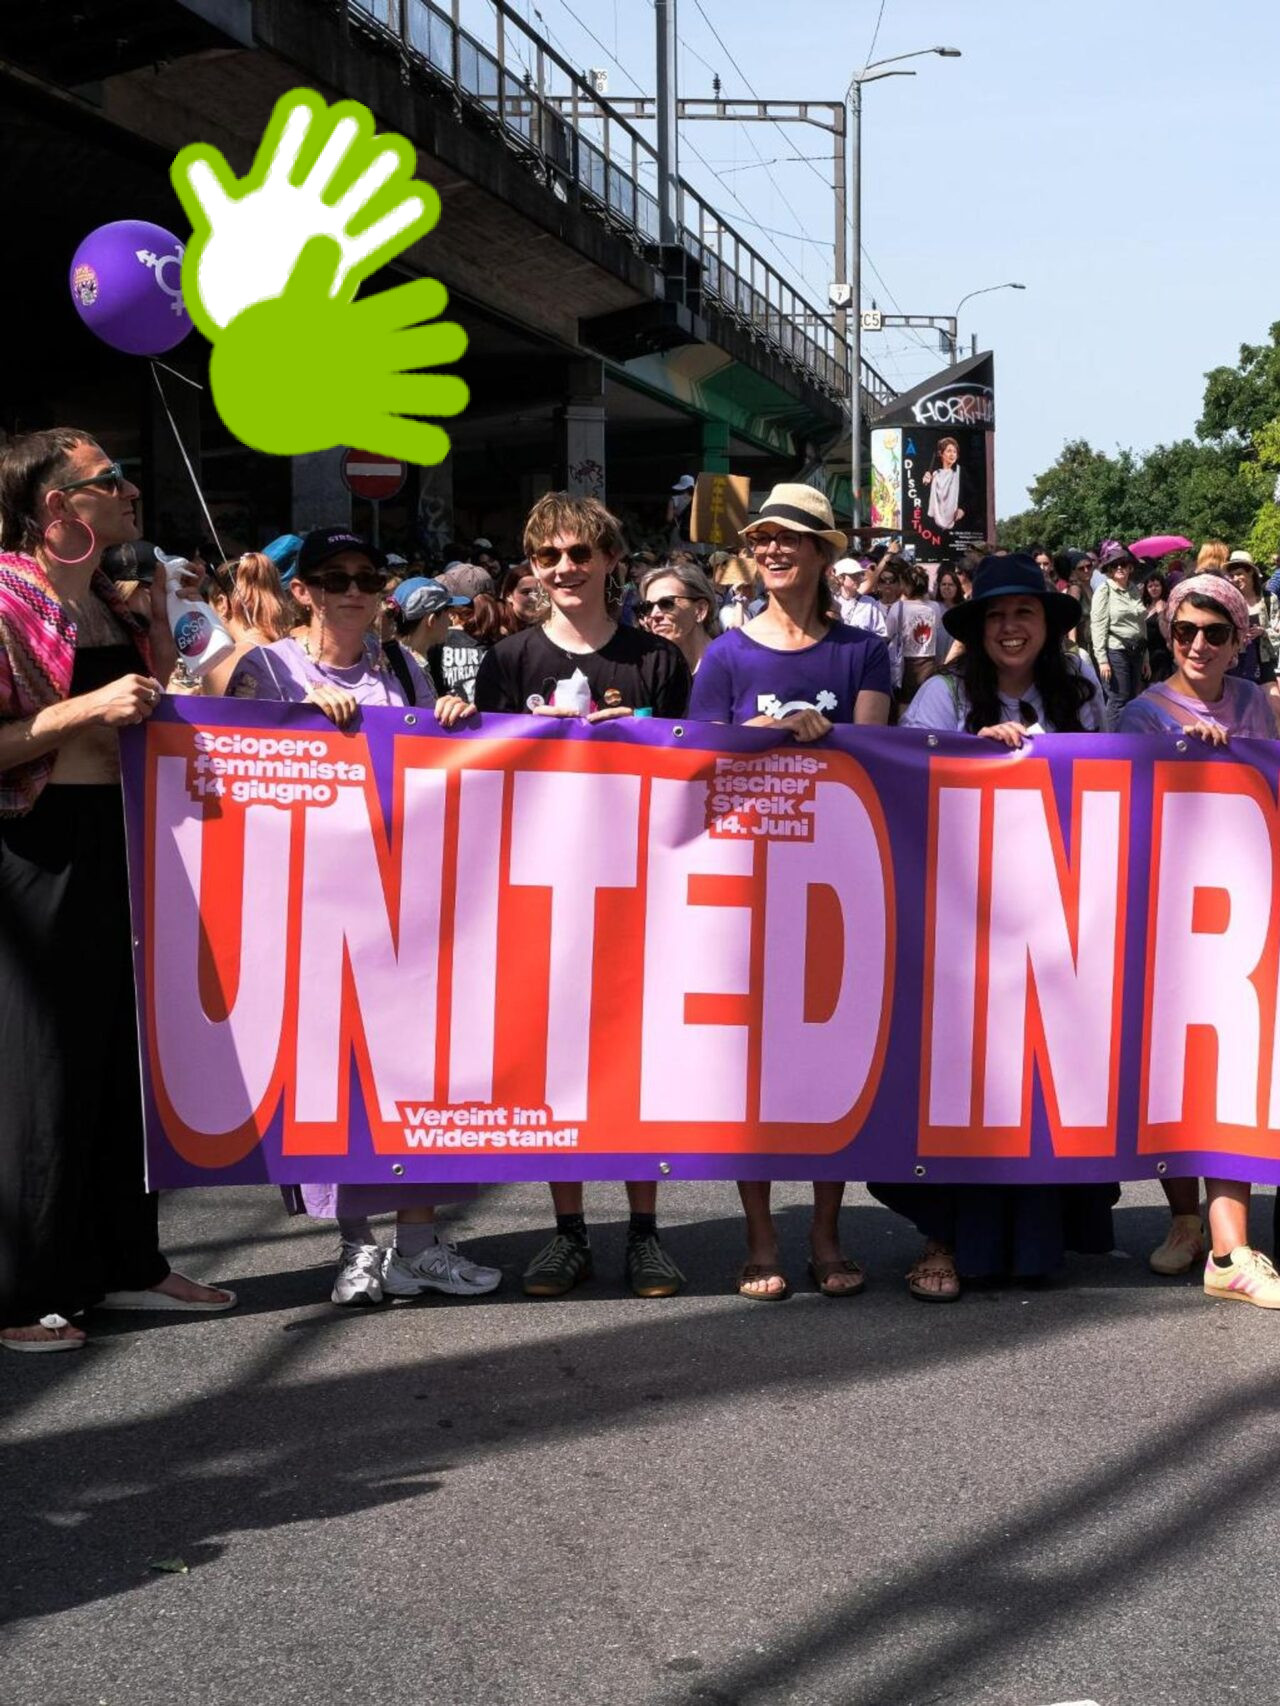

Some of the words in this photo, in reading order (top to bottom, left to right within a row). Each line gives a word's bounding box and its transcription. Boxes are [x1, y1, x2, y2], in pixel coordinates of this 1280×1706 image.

[863, 313, 880, 327] C5
[194, 731, 328, 758] Sciopero
[193, 754, 366, 781] femminista
[715, 754, 828, 774] Feminis-
[193, 777, 226, 797] 14
[231, 779, 331, 803] giugno
[713, 775, 809, 794] tischer
[711, 794, 797, 815] Streik
[712, 815, 747, 834] 14.
[751, 816, 808, 836] Juni
[152, 755, 886, 1136] UNITED
[928, 786, 1121, 1128] IN
[404, 1107, 508, 1126] Vereint
[513, 1106, 547, 1126] im
[403, 1128, 579, 1148] Widerstand!
